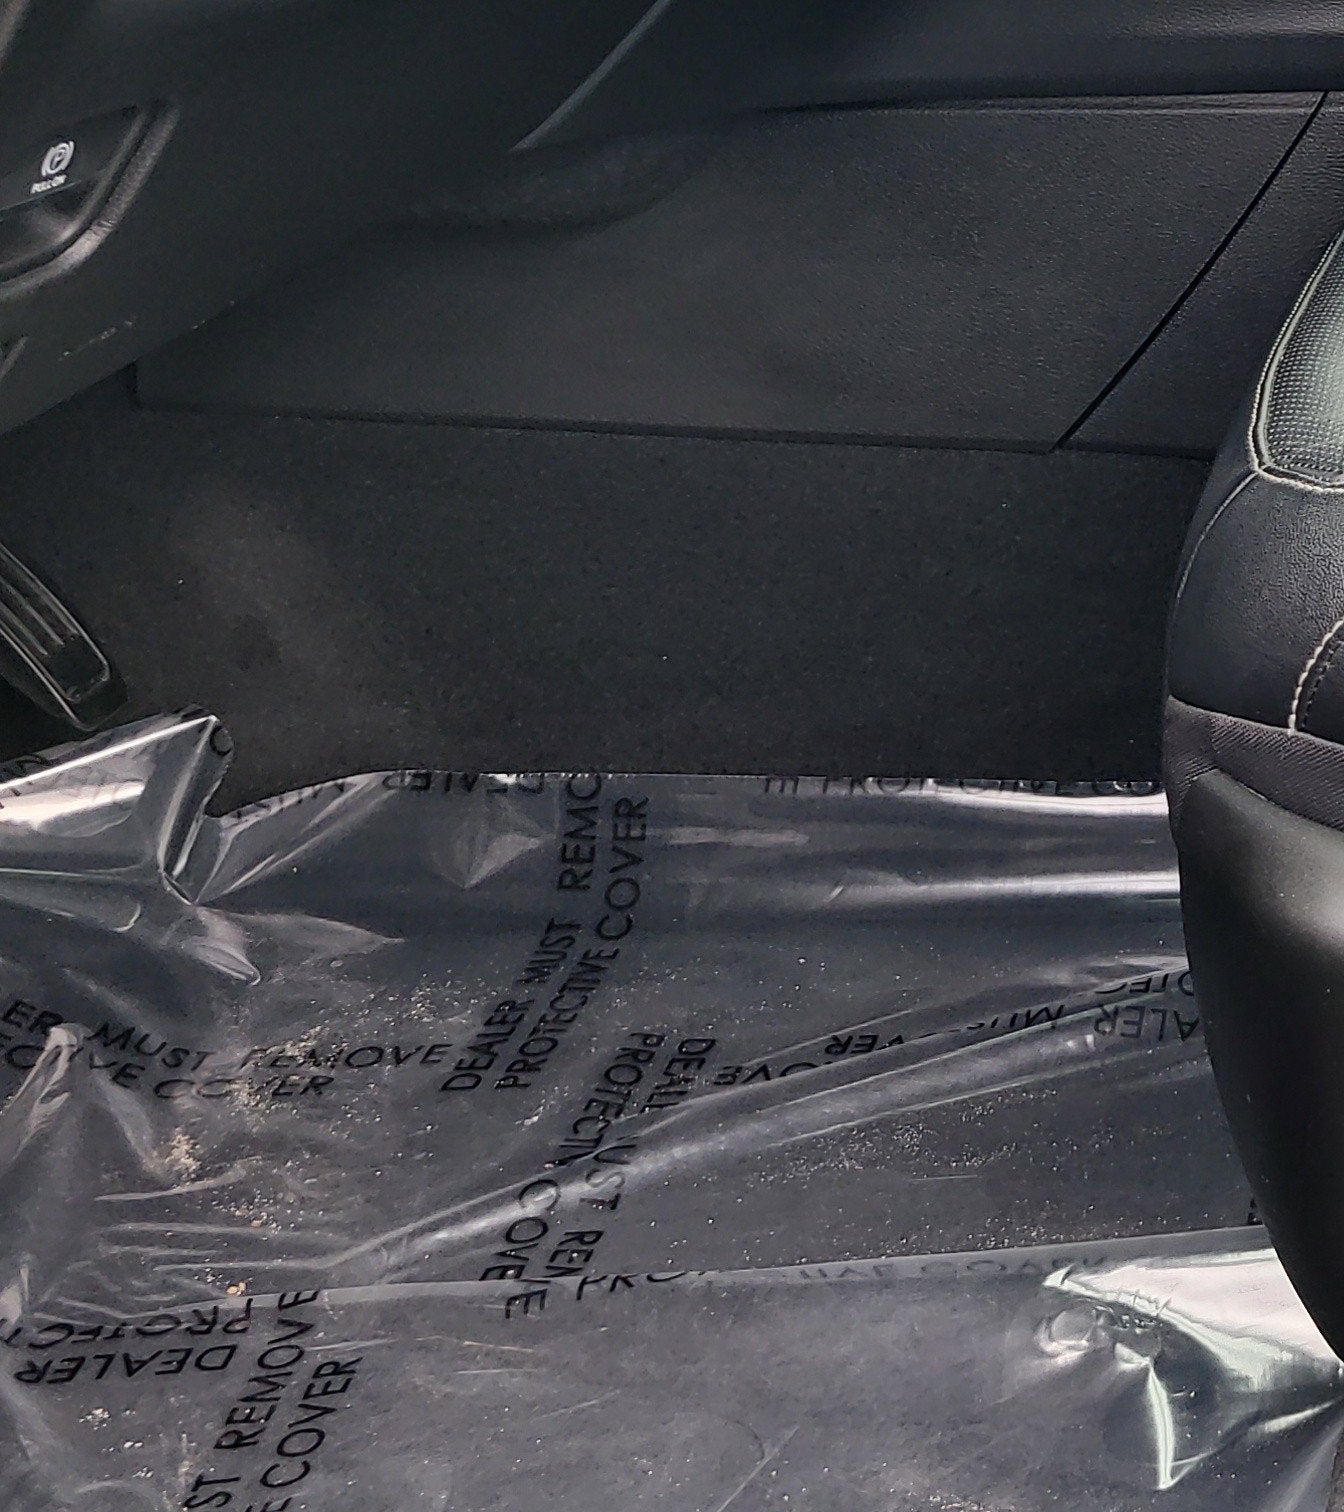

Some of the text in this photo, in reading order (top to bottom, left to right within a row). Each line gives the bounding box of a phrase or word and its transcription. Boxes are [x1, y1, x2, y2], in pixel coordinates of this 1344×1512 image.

[439, 773, 604, 1093] DEALER MUST REMO
[495, 794, 651, 1091] PROTECTIVE COVER
[86, 1022, 225, 1071] MUST
[557, 1031, 666, 1170] PROTECTIV
[480, 1177, 562, 1282] COVE
[14, 1344, 236, 1385] DEALER
[215, 1287, 320, 1450] REMOVE
[259, 1353, 363, 1491] COVER
